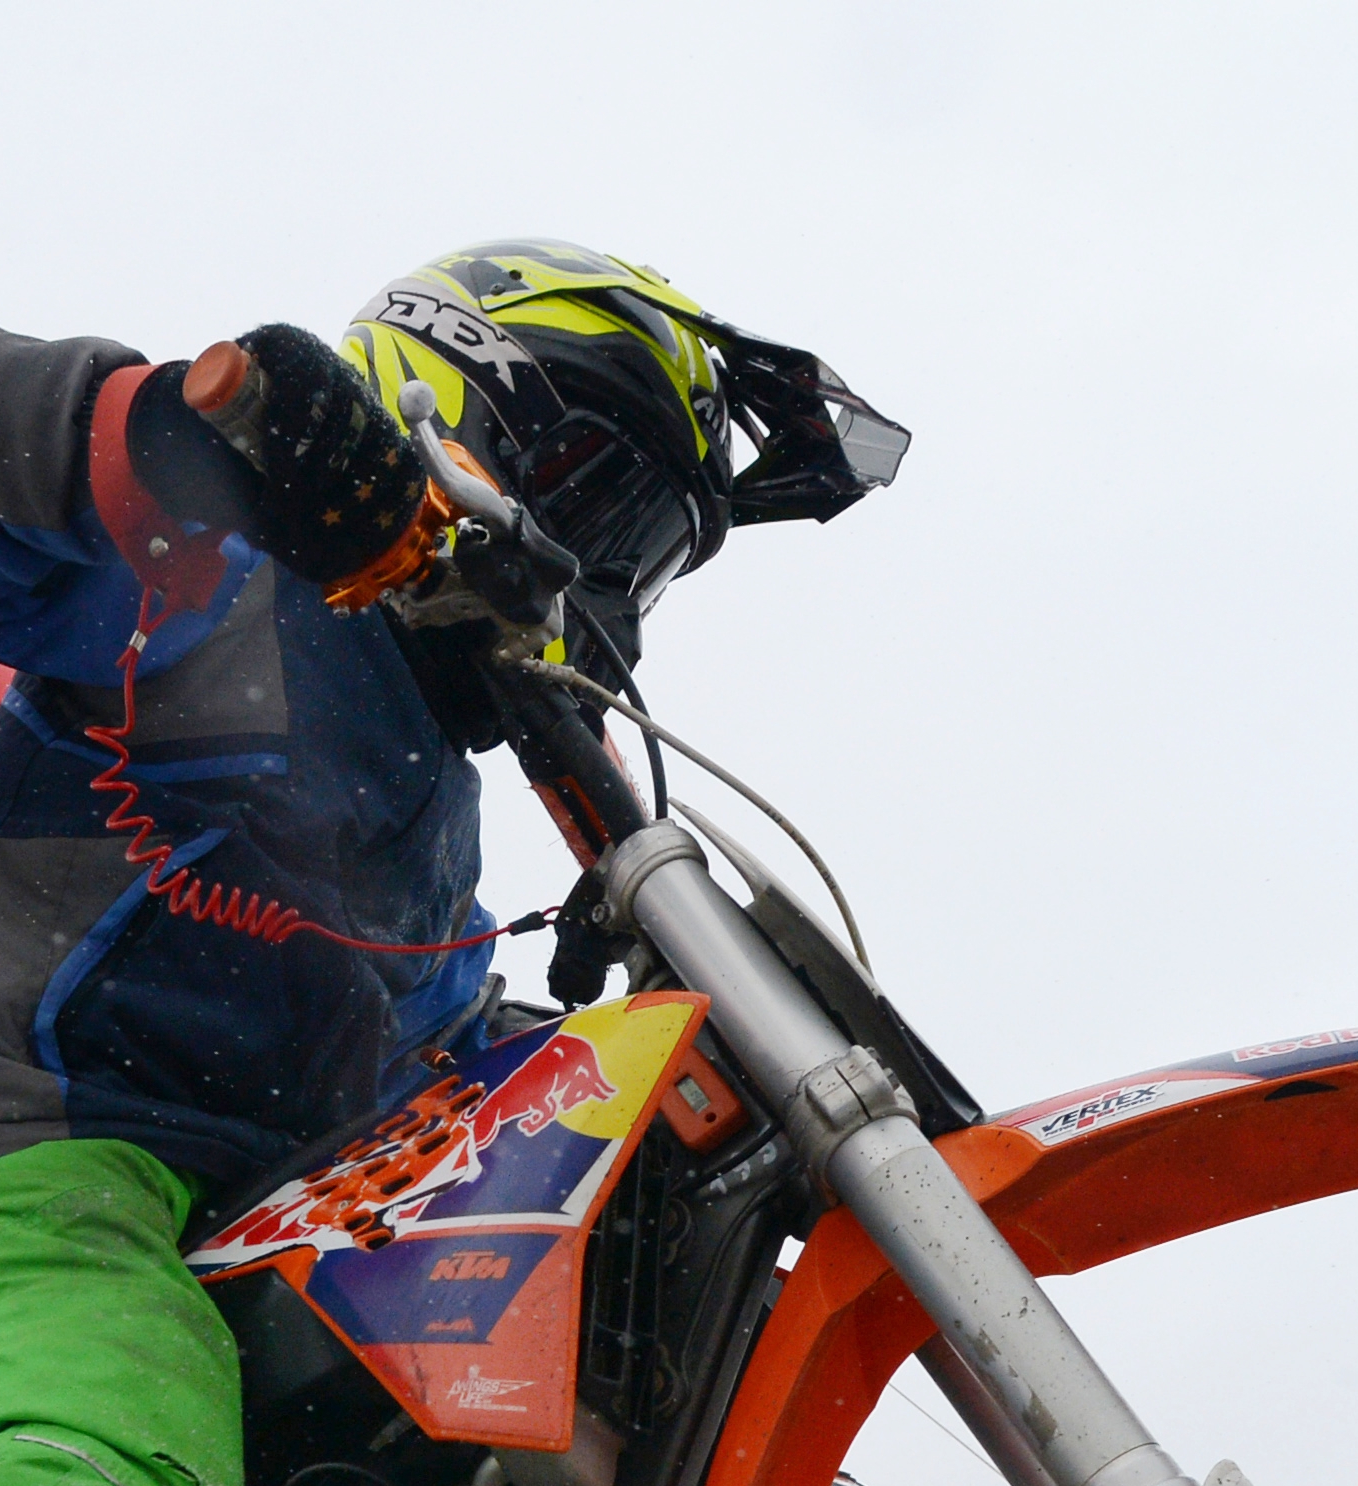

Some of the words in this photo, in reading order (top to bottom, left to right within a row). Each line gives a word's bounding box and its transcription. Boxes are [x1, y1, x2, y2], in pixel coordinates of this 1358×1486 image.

[1235, 1031, 1337, 1061] Red
[1042, 1085, 1157, 1133] VERTEX
[429, 1251, 511, 1281] KTM
